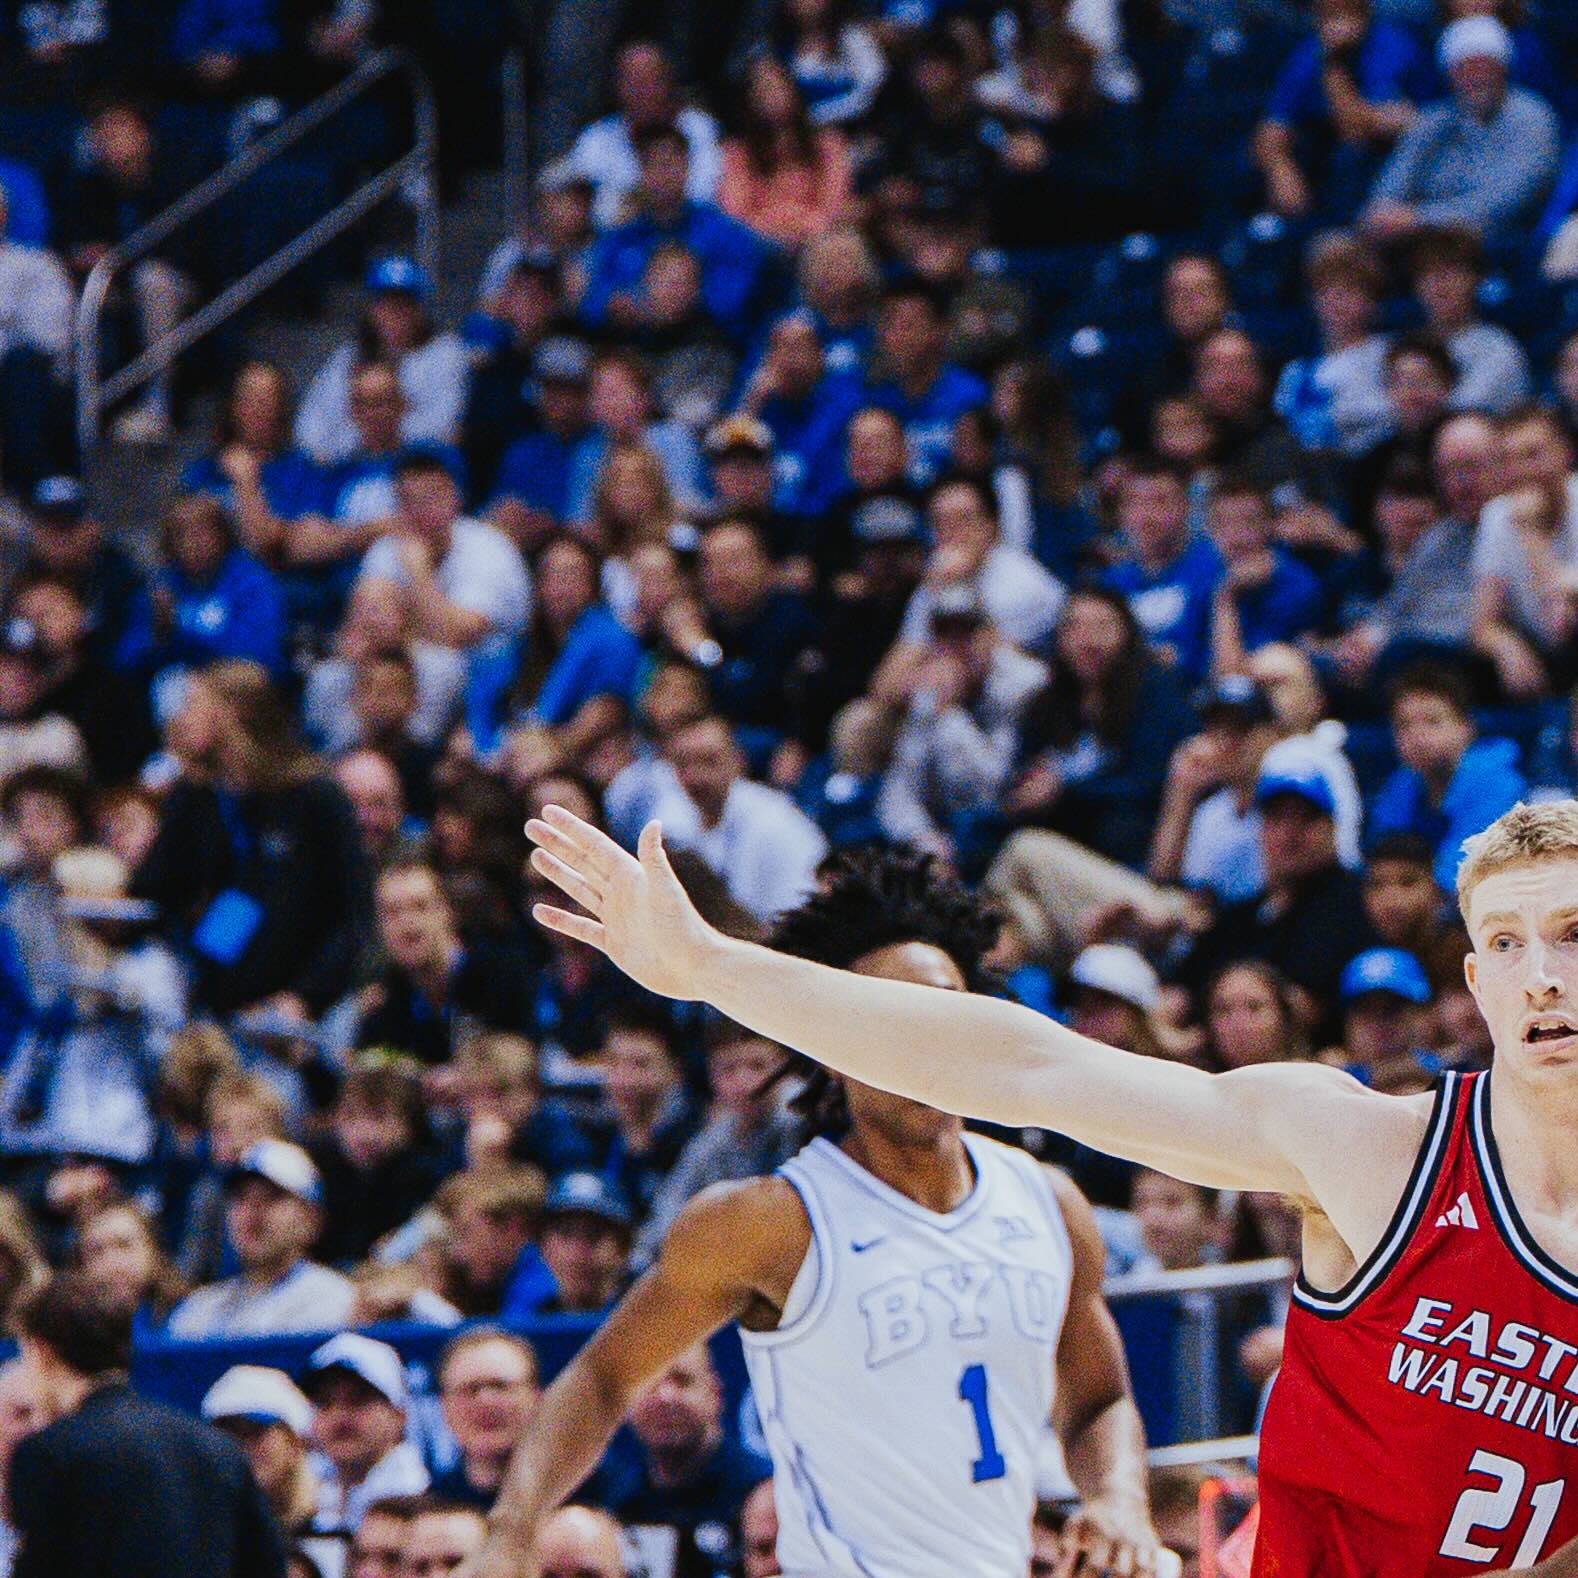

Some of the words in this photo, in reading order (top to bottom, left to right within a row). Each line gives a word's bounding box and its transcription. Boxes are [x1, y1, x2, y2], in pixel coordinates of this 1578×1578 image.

[857, 1261, 1060, 1369] BYU
[958, 1364, 1006, 1483] 1
[1438, 1448, 1565, 1570] 21
